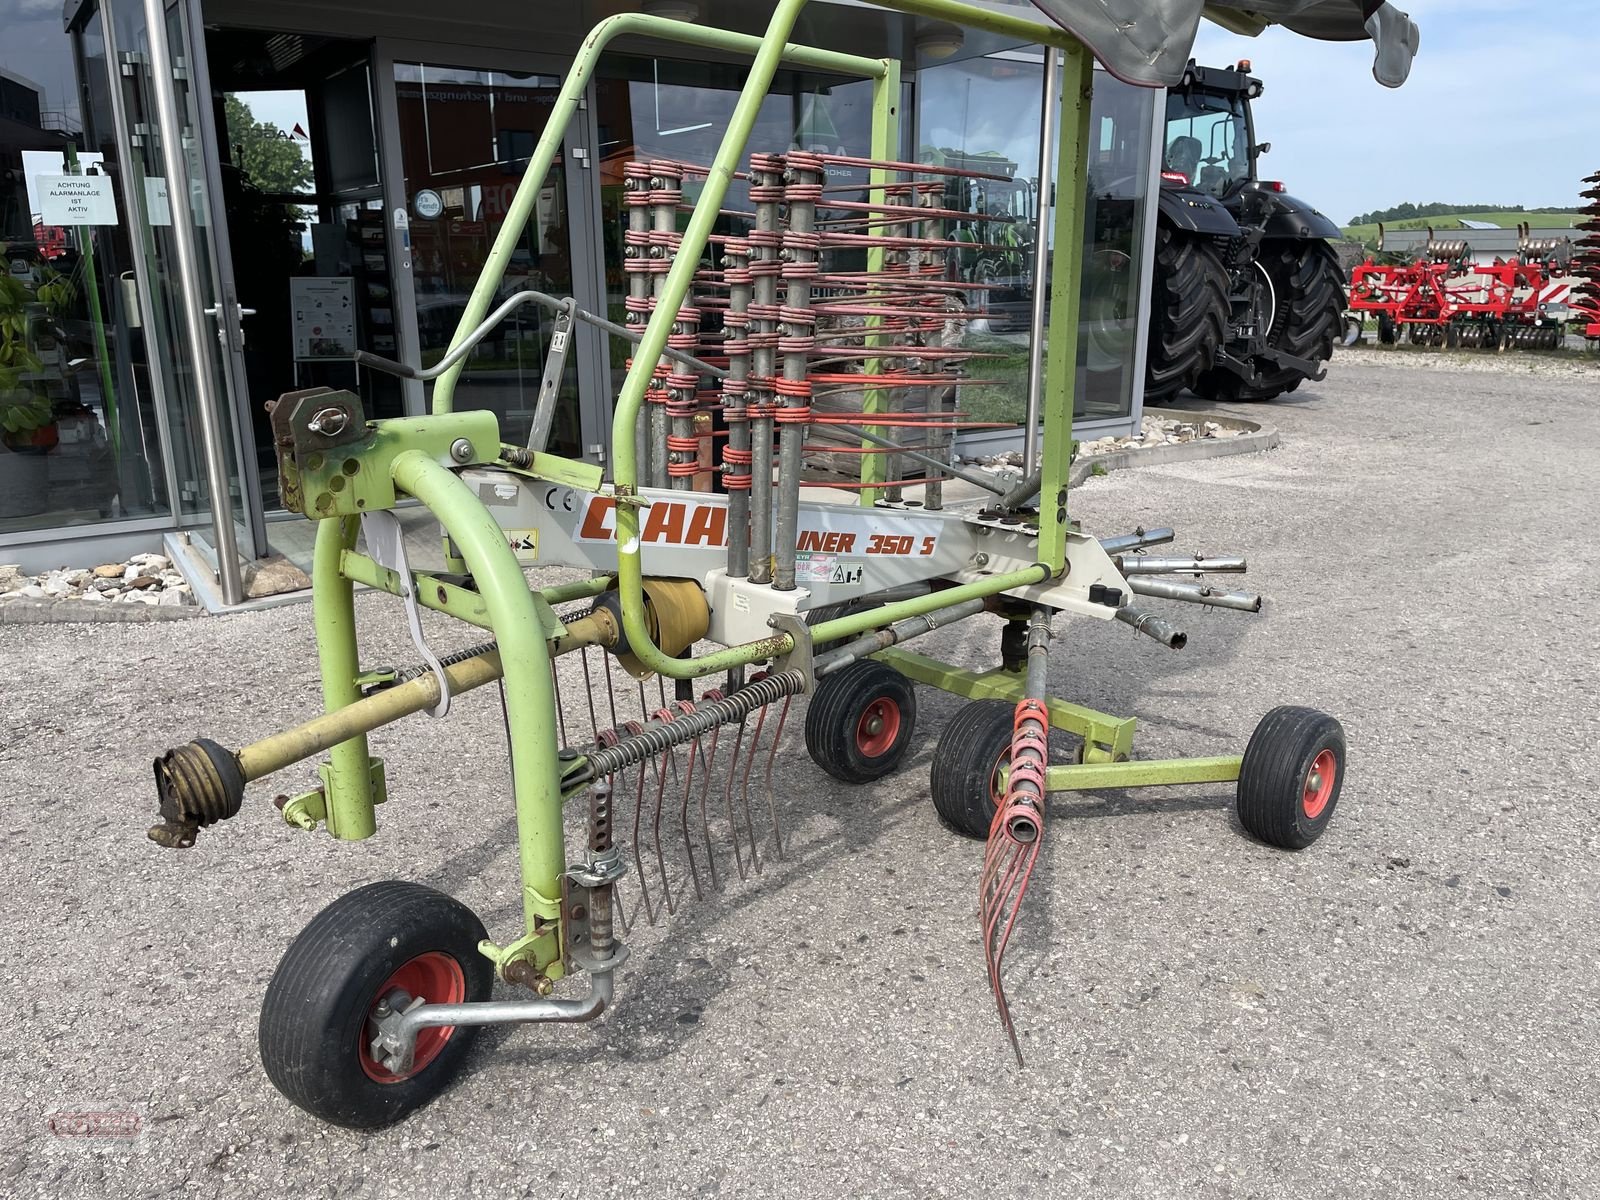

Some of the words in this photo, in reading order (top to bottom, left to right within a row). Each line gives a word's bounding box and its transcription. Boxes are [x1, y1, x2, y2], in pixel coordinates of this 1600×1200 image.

[418, 202, 438, 210] Fendt
[797, 530, 857, 553] INER
[866, 534, 915, 555] 350
[919, 536, 936, 555] S
